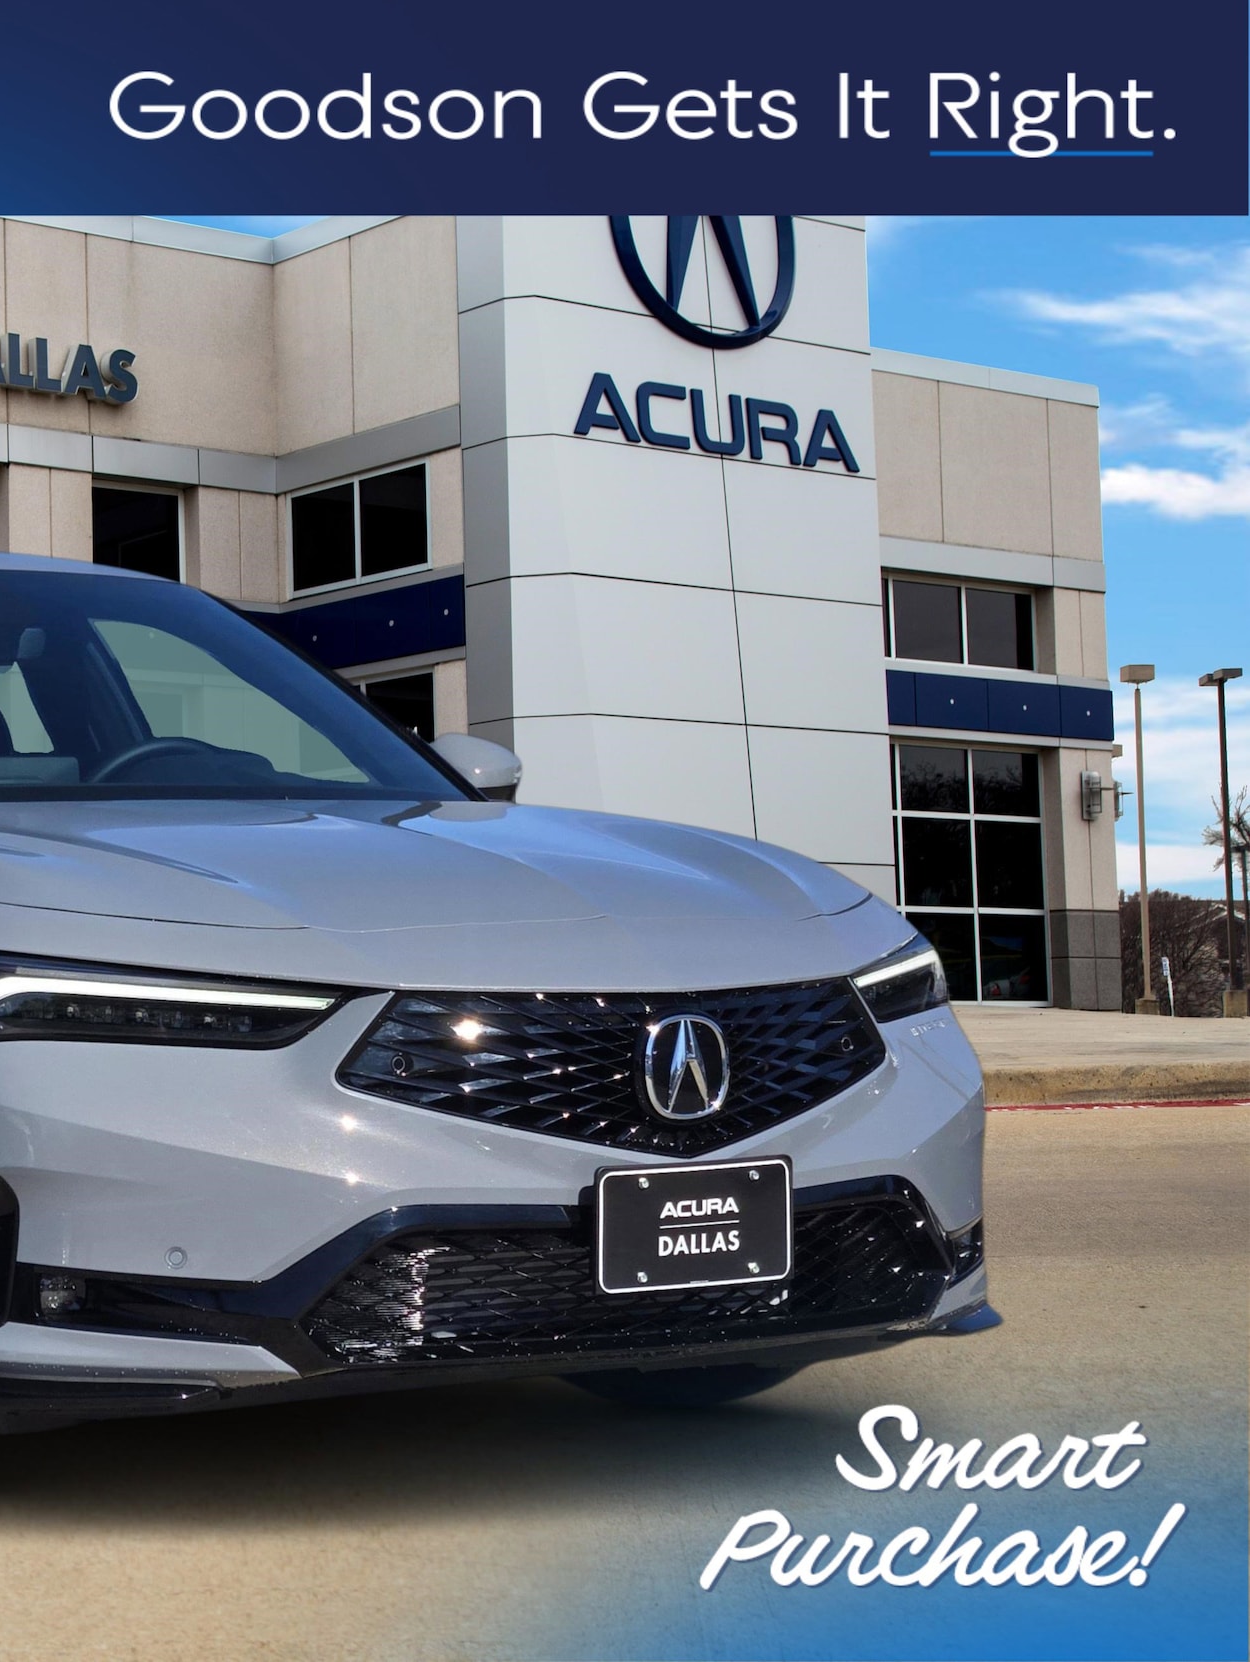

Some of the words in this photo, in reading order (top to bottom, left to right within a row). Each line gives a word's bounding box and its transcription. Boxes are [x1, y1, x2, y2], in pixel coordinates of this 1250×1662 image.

[574, 372, 860, 474] ACURA
[659, 1196, 740, 1219] ACURA
[658, 1229, 740, 1257] DALLAS
